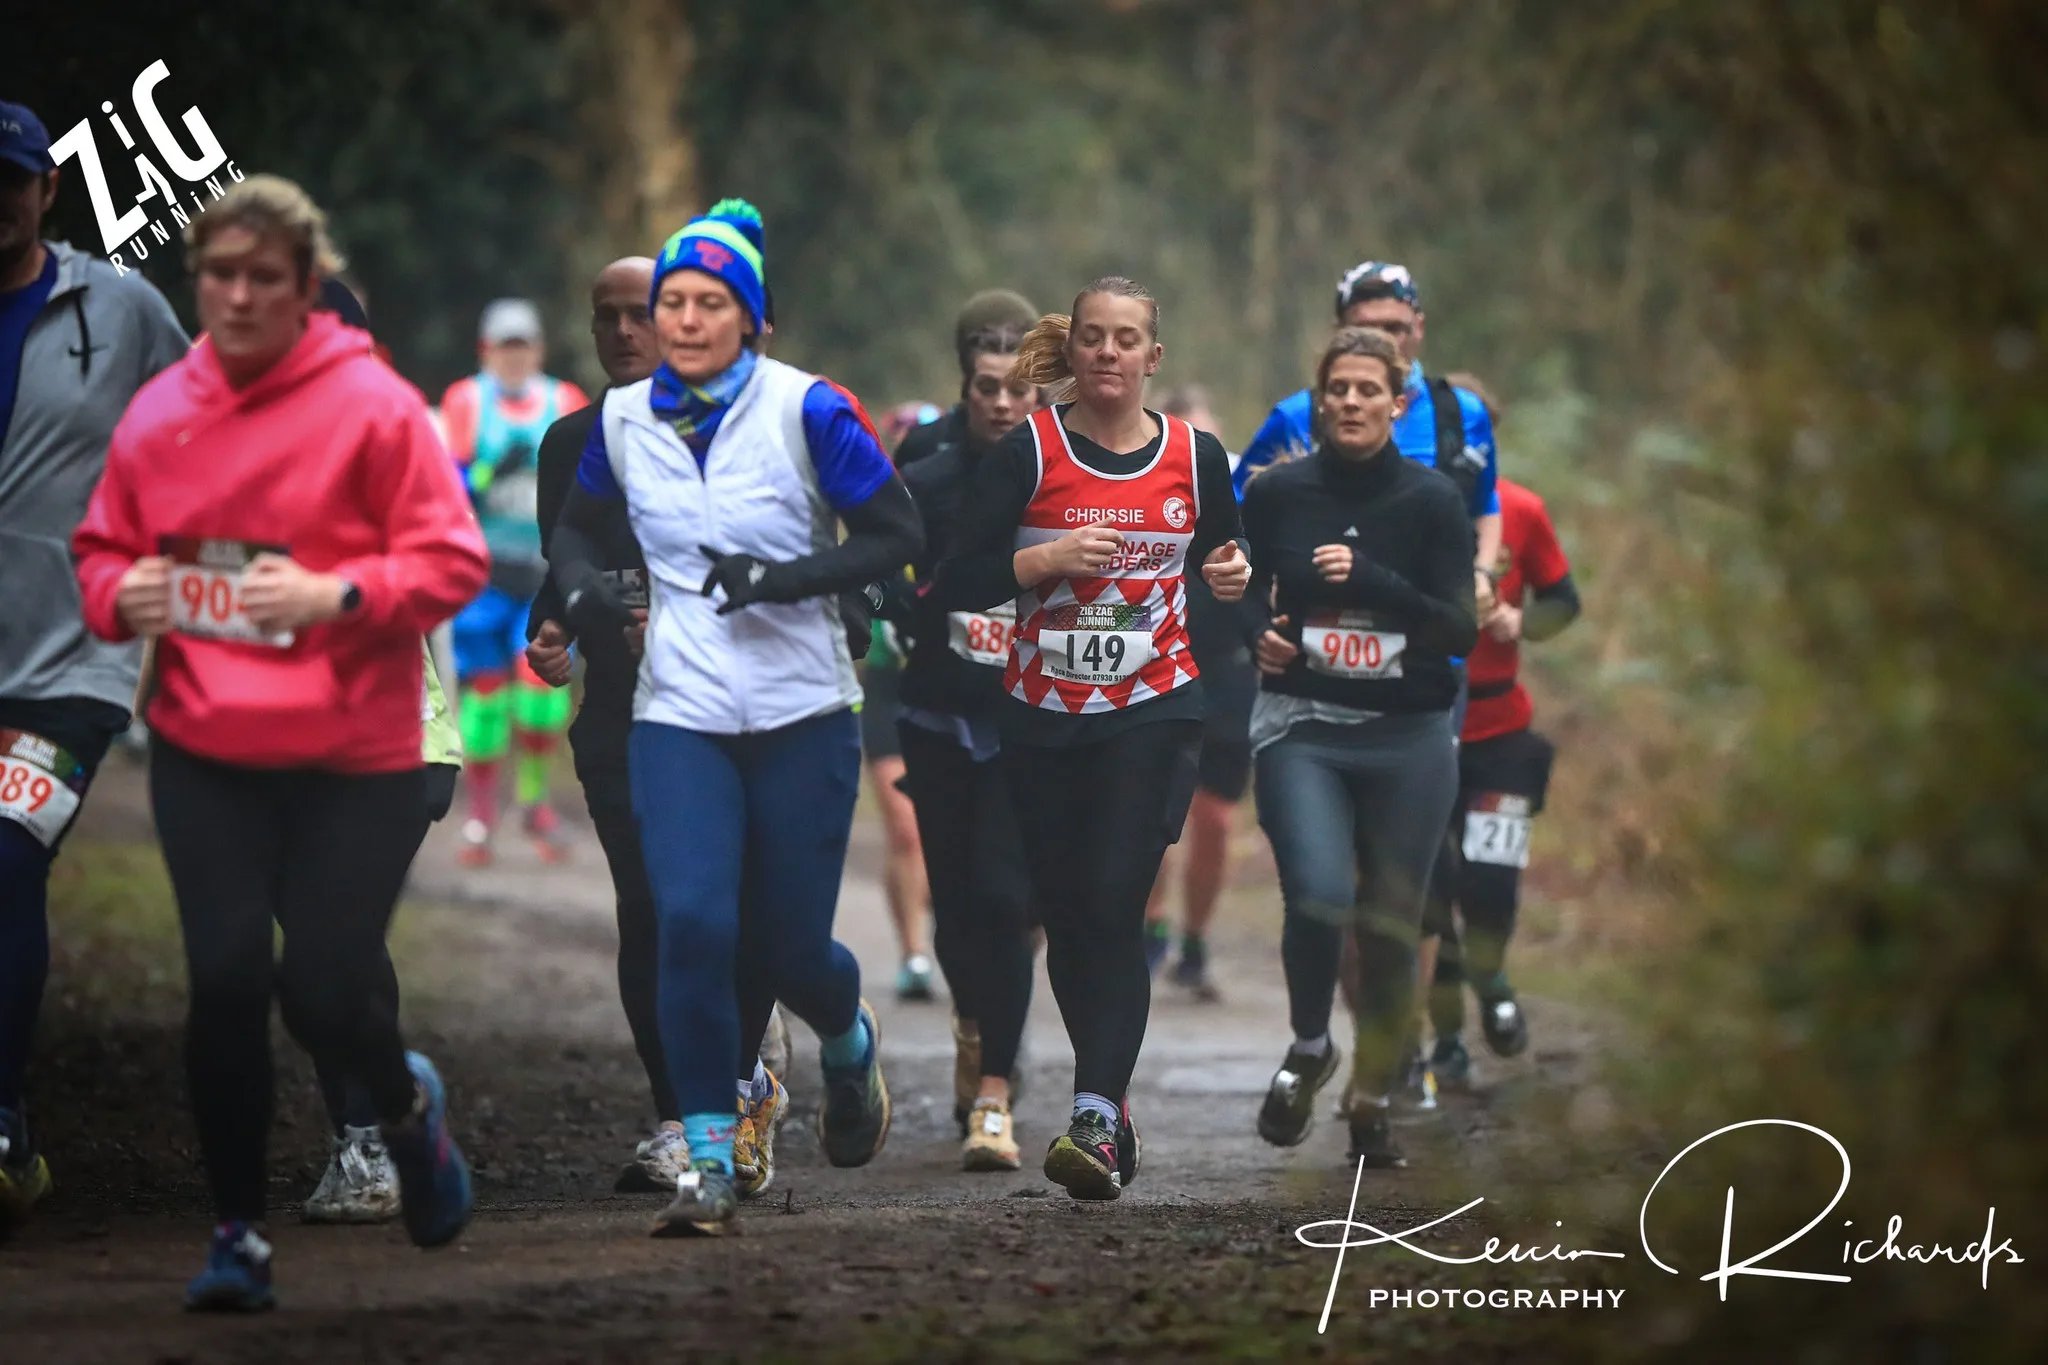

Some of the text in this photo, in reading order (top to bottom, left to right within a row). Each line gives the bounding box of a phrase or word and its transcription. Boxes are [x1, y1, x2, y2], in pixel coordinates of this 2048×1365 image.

[1064, 508, 1145, 524] CHRISSIE
[1113, 541, 1177, 558] NAGE
[1102, 555, 1162, 572] DERS
[181, 572, 247, 625] 90
[1080, 606, 1113, 616] ZIG ZAG
[1076, 616, 1116, 627] RUNNING
[1066, 633, 1126, 672] 149
[1323, 632, 1382, 669] 900
[1066, 670, 1091, 681] Director
[0, 762, 53, 814] 89
